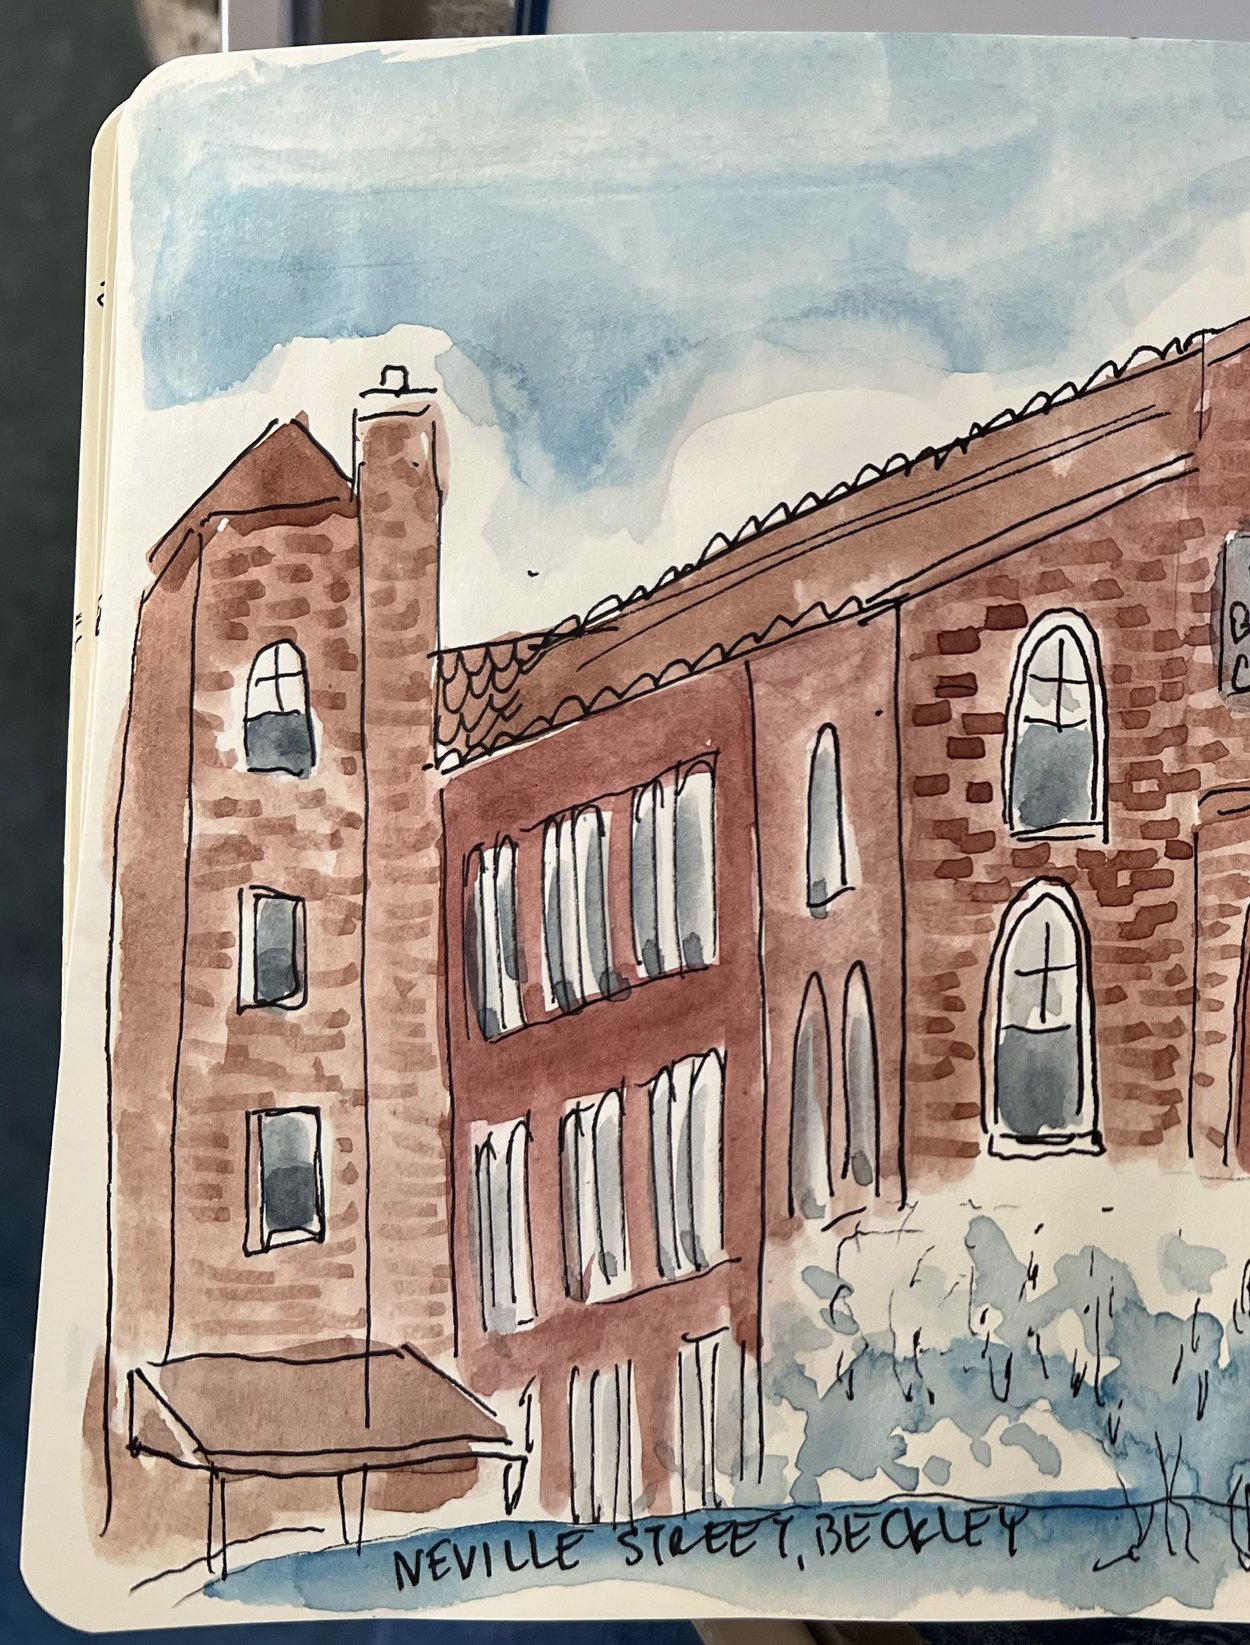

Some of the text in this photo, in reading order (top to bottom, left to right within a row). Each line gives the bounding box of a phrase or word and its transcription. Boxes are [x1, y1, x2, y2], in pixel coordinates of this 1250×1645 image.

[393, 1505, 1030, 1592] NEVILLE STREET, BECKLEY
